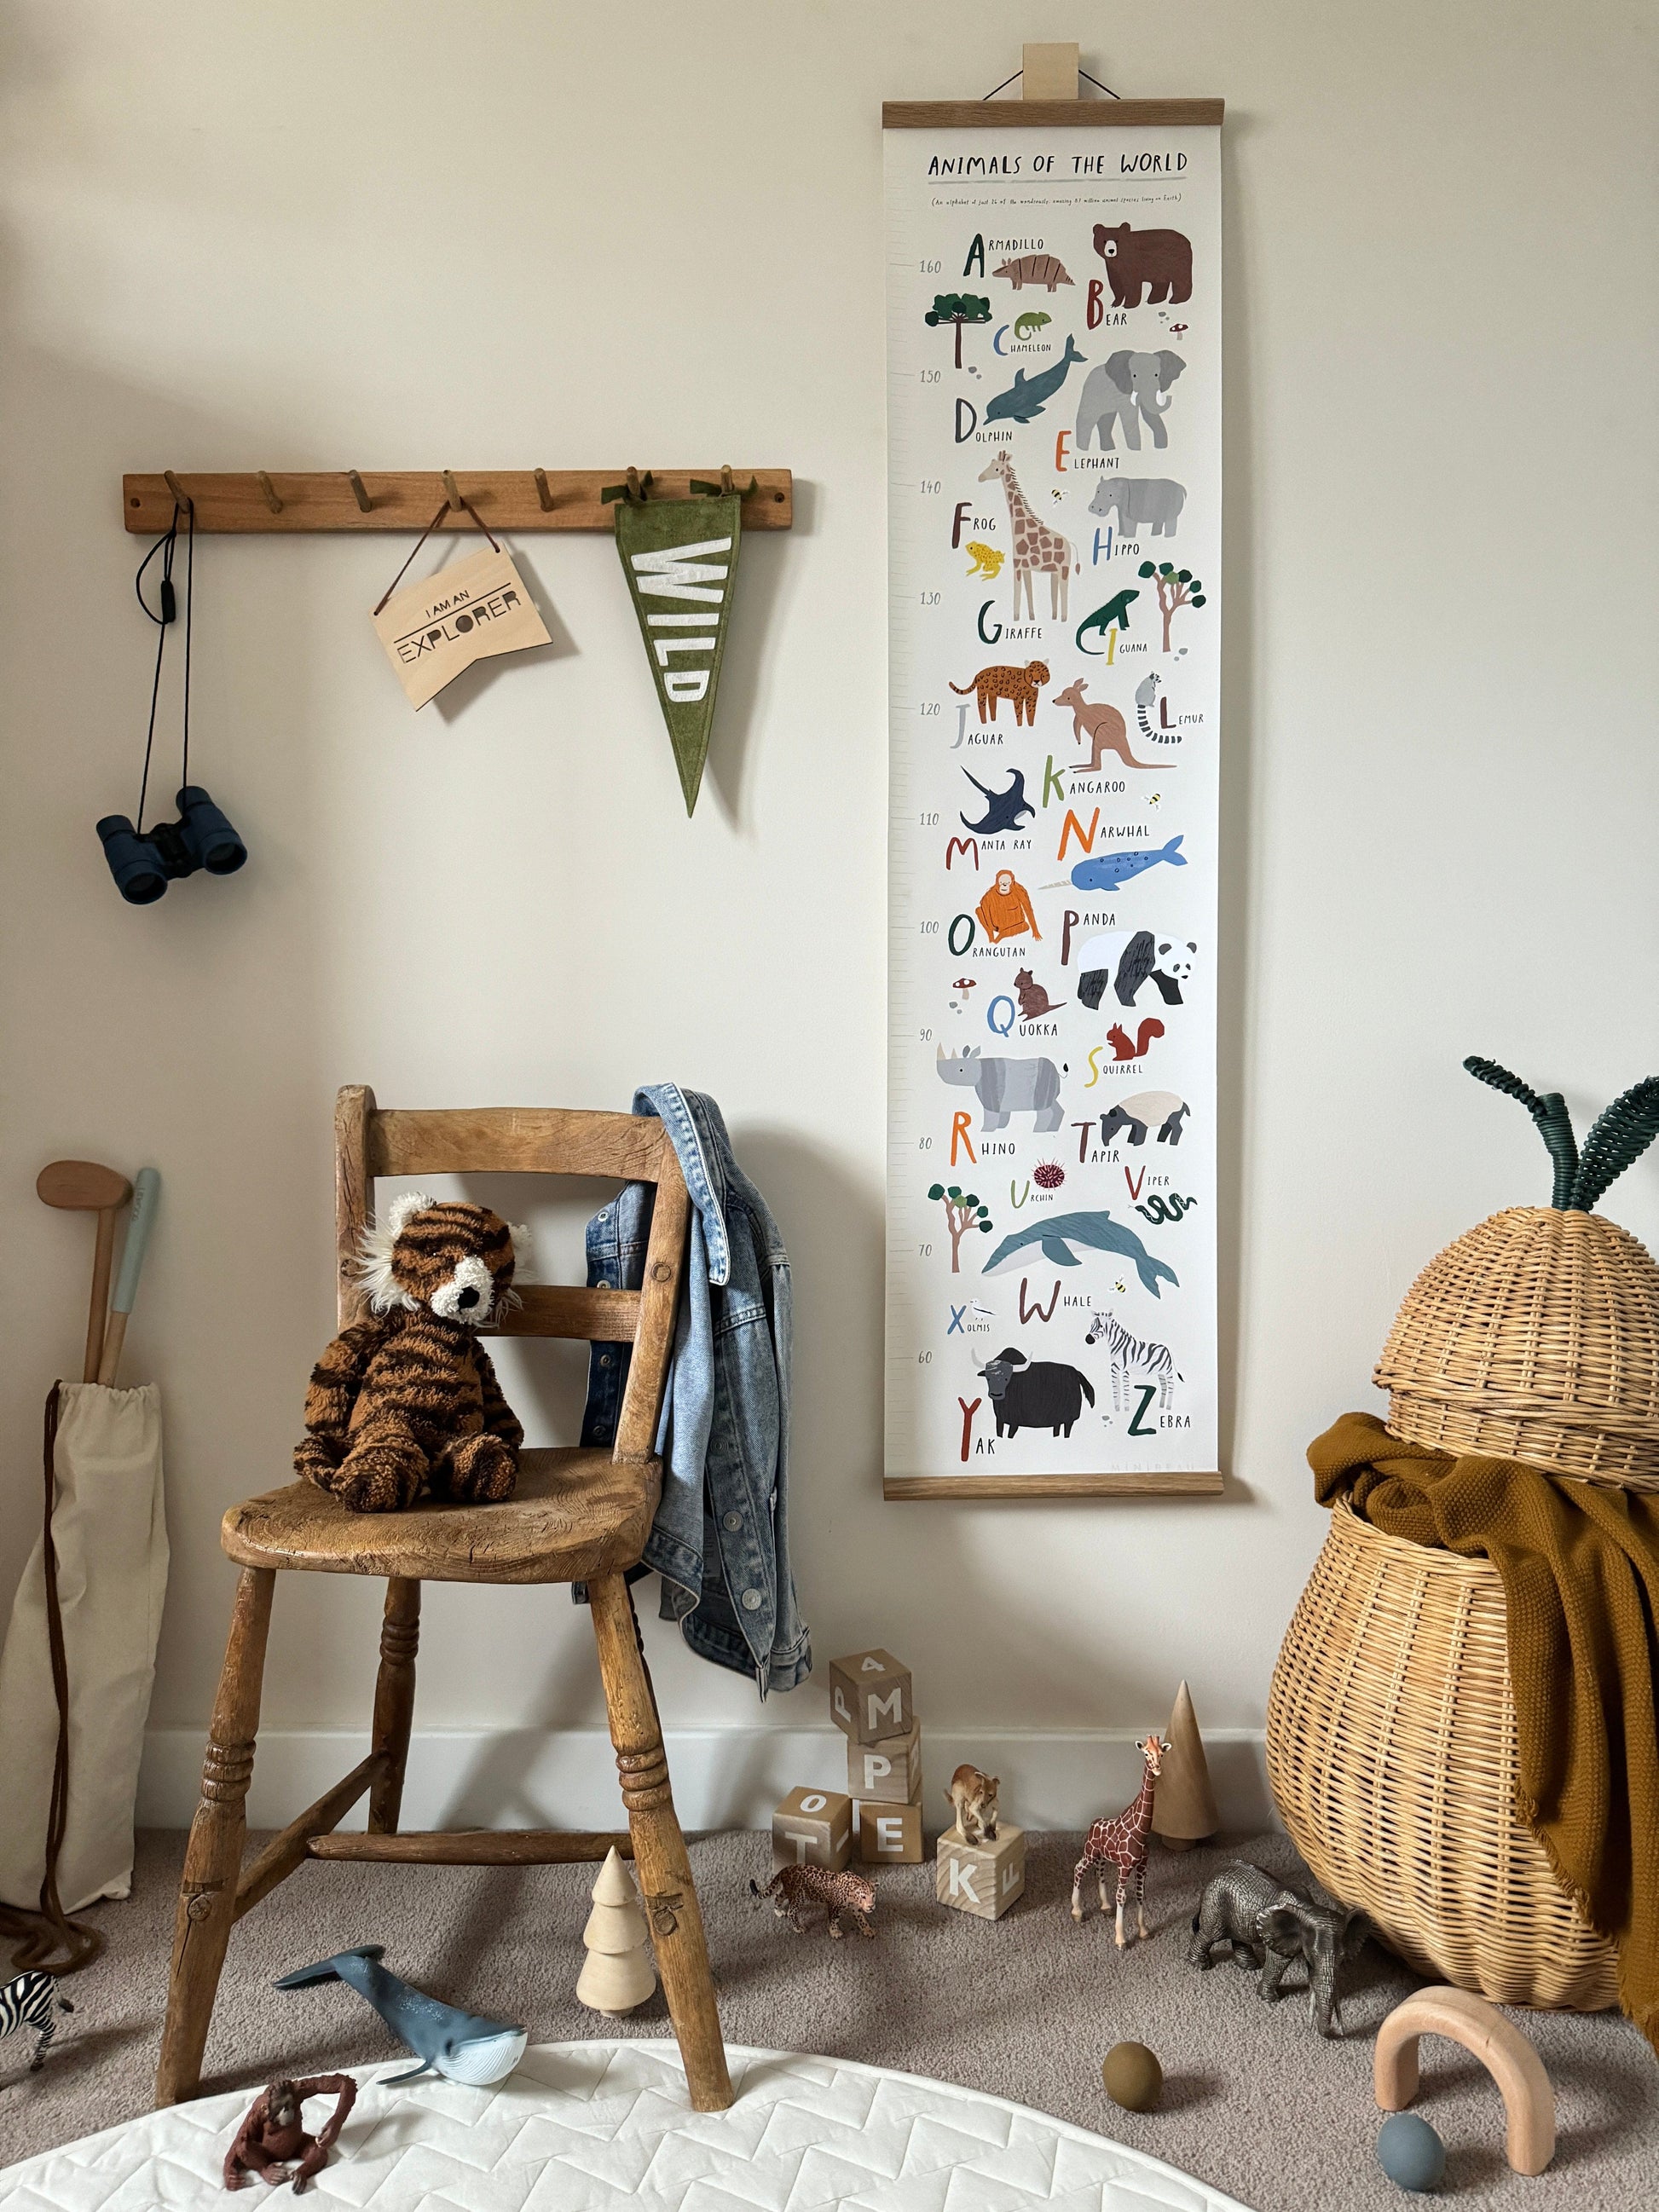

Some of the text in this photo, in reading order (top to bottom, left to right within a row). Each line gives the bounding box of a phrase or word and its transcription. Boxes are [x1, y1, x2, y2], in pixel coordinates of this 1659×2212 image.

[928, 153, 1188, 176] ANIMALS OF THE WORLD
[920, 261, 941, 273] 160
[963, 234, 1043, 278] ARMADILLO
[1087, 280, 1127, 330] BEAR
[994, 325, 1051, 355] CHAMELEON
[921, 371, 940, 383] 150
[955, 398, 1013, 443] DOLPHIN
[1055, 430, 1119, 471] ELEPHANT
[921, 481, 940, 493] 140
[951, 502, 996, 549] FROG
[1093, 527, 1140, 564] HIPPO
[425, 590, 470, 618] I AM AN
[921, 592, 940, 604] 130
[397, 591, 521, 664] EXPLORER
[630, 537, 731, 702] WILD
[978, 600, 1042, 644] GIRAFFE
[920, 703, 939, 715] 120
[1160, 696, 1204, 729] LEMUR
[1042, 755, 1125, 808] KANGAROO
[920, 814, 939, 826] 110
[1057, 807, 1149, 861] NARWHAL
[945, 837, 1032, 870] MANTA RAY
[920, 922, 939, 934] 100
[948, 914, 1026, 956] ORANGUTAN
[1061, 910, 1116, 965] PANDA
[987, 996, 1058, 1037] QUOKKA
[920, 1030, 932, 1041] 90
[919, 1138, 932, 1149] 80
[951, 1112, 1015, 1166] RHINO
[1071, 1122, 1119, 1163] TAPIR
[1010, 1180, 1054, 1209] URCHIN
[1124, 1166, 1170, 1200] VIPER
[919, 1245, 932, 1256] 70
[1020, 1278, 1092, 1324] WHALE
[918, 1352, 932, 1363] 60
[1128, 1384, 1190, 1436] ZEBRA
[958, 1397, 996, 1461] YAK
[861, 1656, 886, 1672] A
[868, 1688, 902, 1730] M
[864, 1754, 891, 1789] P
[800, 1794, 826, 1812] O
[785, 1832, 818, 1864] T
[876, 1817, 903, 1851] E
[949, 1858, 981, 1904] K
